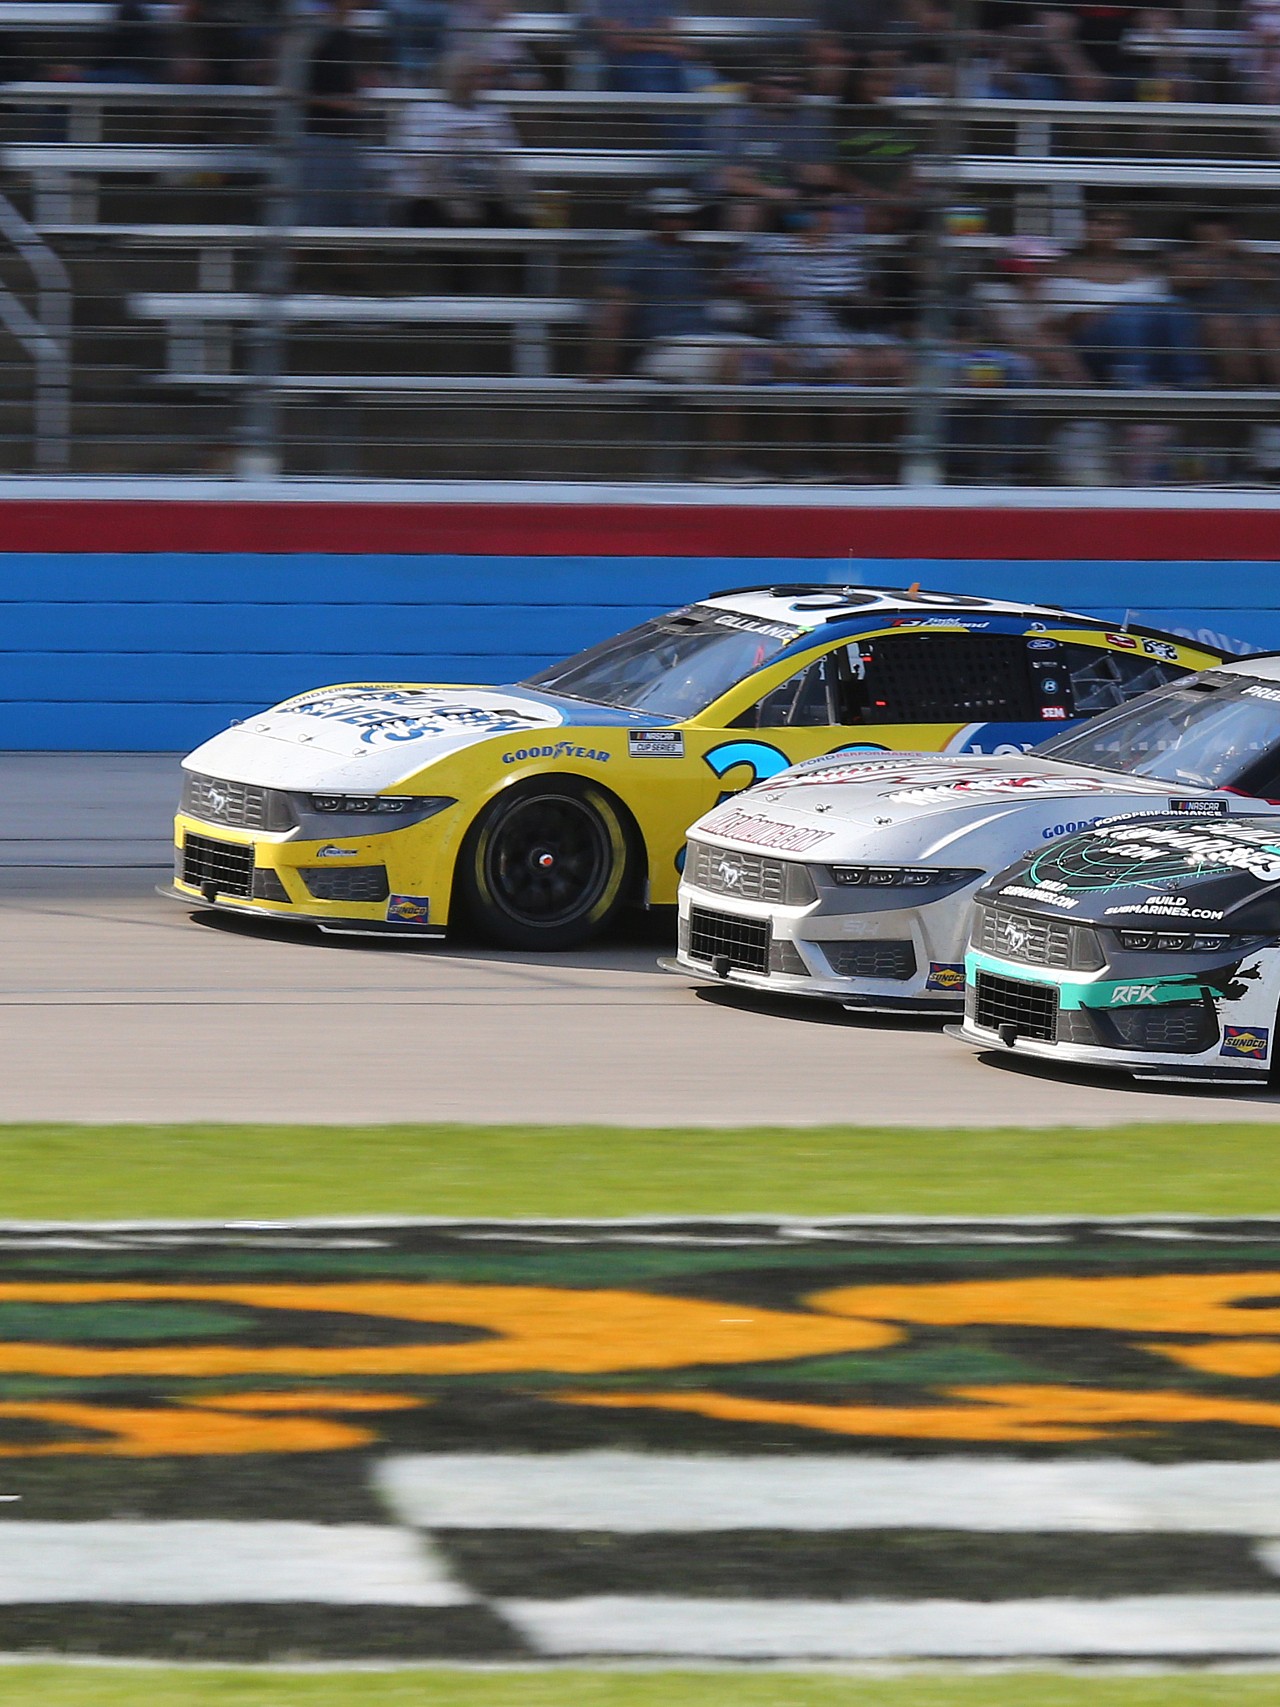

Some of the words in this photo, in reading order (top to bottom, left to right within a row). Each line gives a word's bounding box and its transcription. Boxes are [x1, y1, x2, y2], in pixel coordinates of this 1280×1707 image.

[714, 615, 797, 639] GILLILAND
[1042, 708, 1065, 718] SEM
[1188, 802, 1219, 811] NASCAR
[1034, 879, 1068, 892] BUILD
[1146, 896, 1188, 907] BUILD
[1104, 904, 1224, 921] SUBMARINES.COM
[931, 973, 965, 982] SUNOCO
[1111, 986, 1157, 1003] RFK
[1226, 1037, 1266, 1048] SUNOCO
